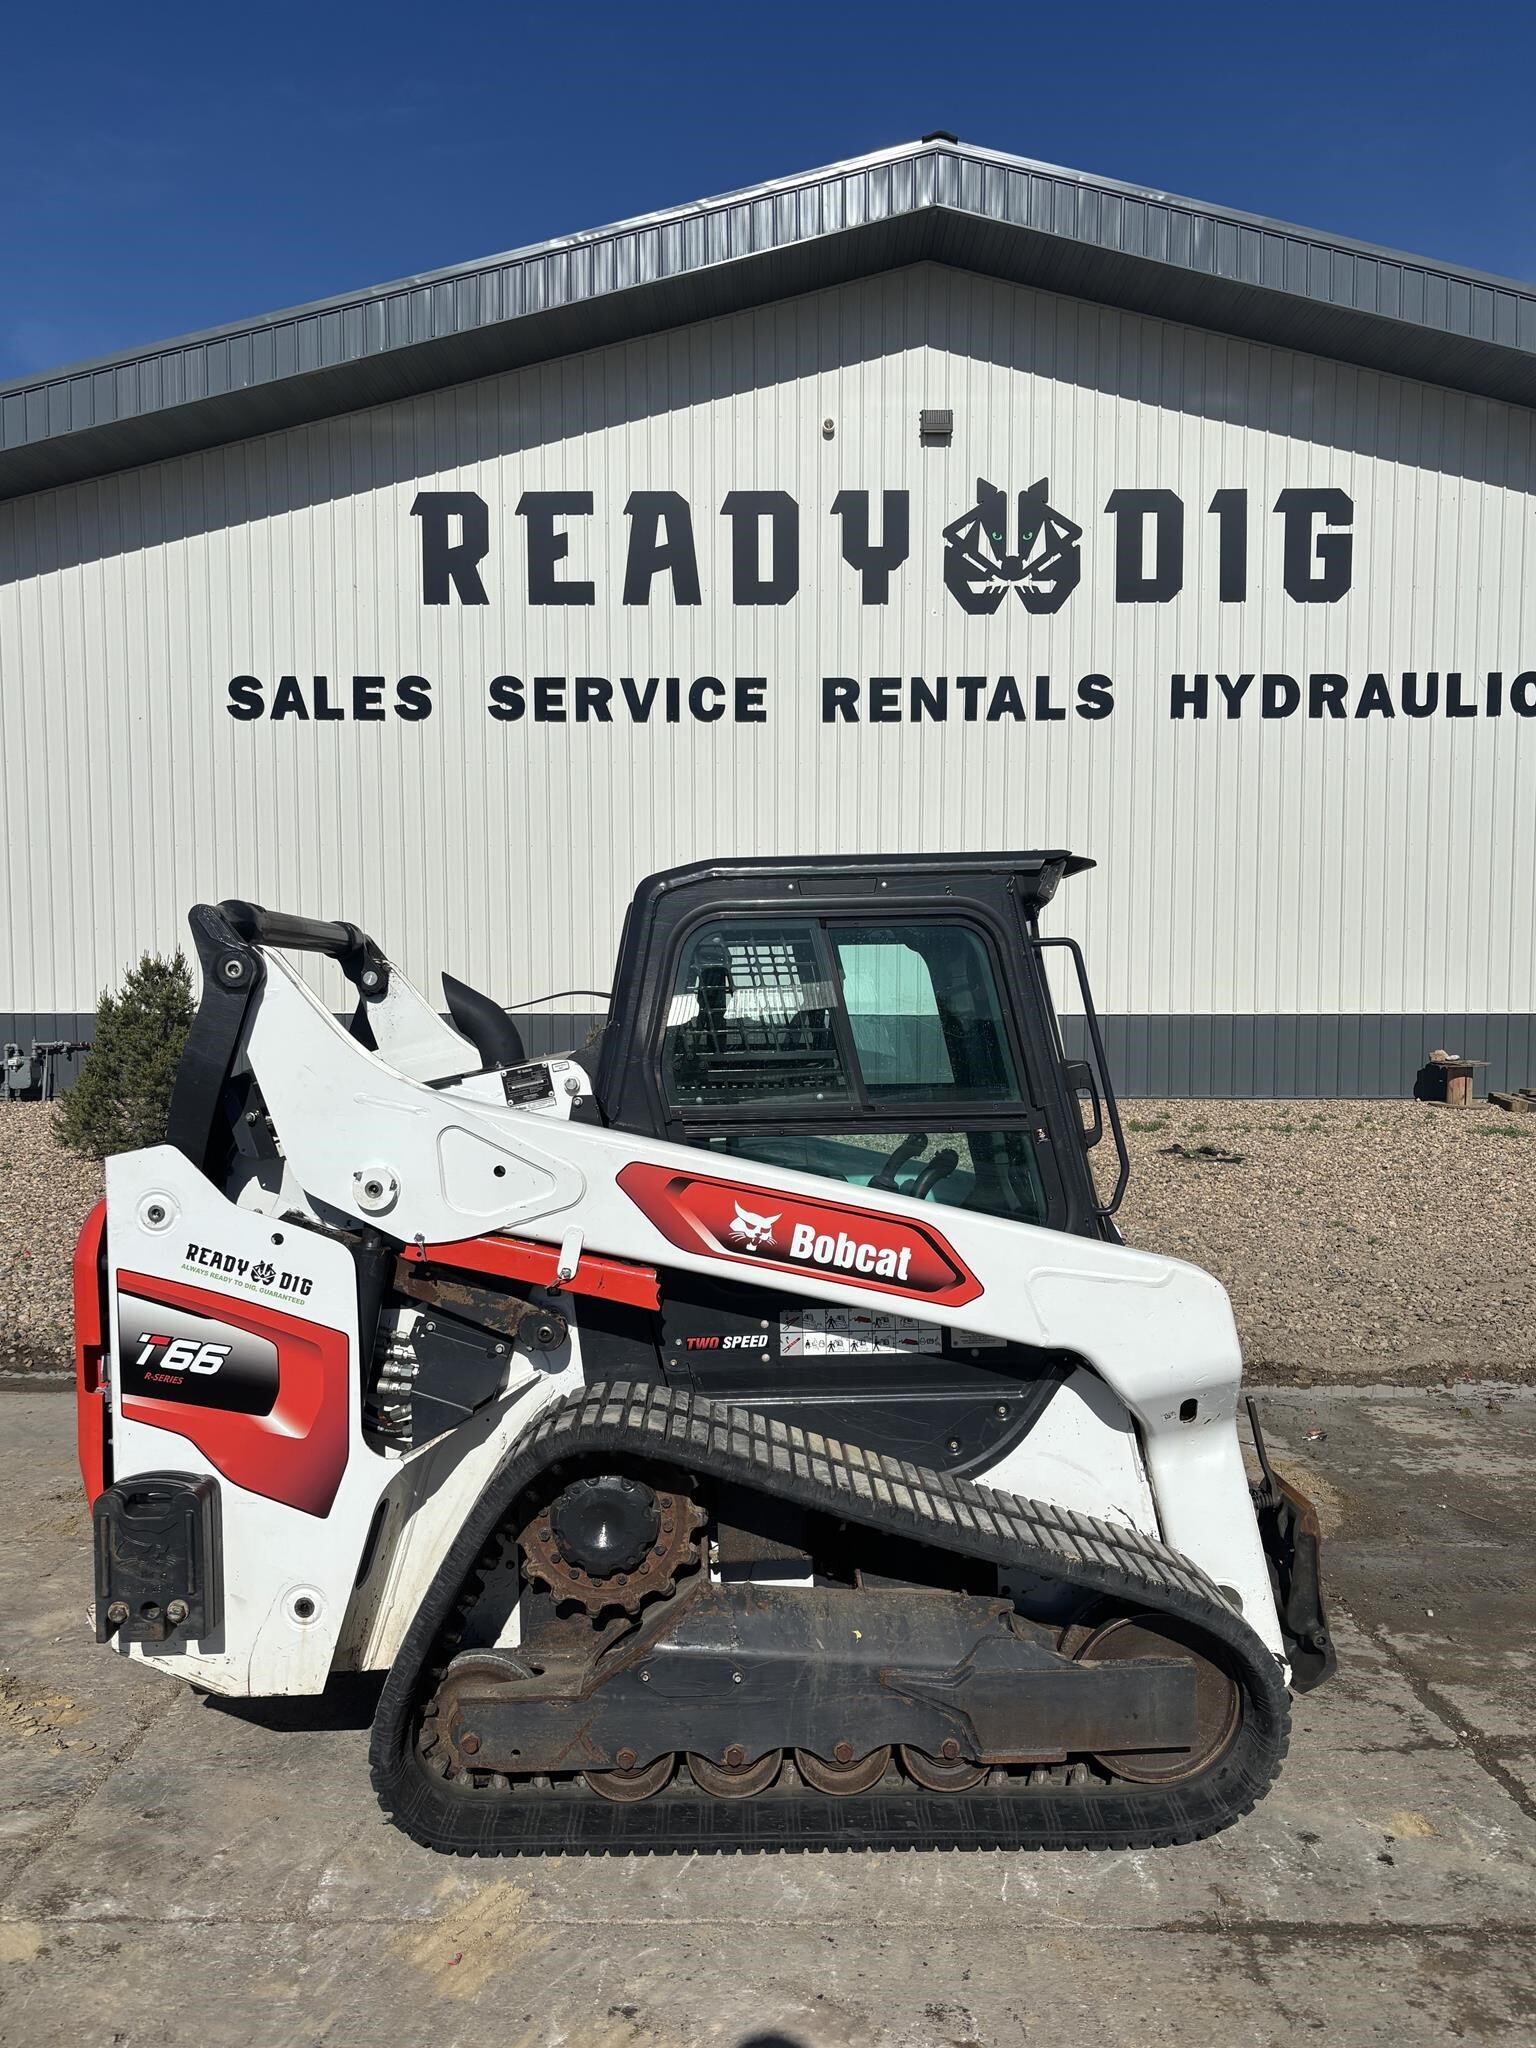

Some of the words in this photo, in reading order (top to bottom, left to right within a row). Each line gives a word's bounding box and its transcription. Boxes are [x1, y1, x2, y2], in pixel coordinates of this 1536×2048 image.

[410, 490, 910, 606] READY
[1103, 488, 1354, 603] DIG
[227, 675, 432, 721] SALES
[488, 675, 767, 723] SERVICE
[822, 673, 1115, 723] RENTALS
[1170, 671, 1536, 719] HYDRAULIC
[185, 1243, 250, 1277] READY
[278, 1271, 313, 1296] DIG
[789, 1222, 912, 1281] Bobcat
[181, 1263, 209, 1277] ALWAYS
[209, 1270, 233, 1285] READY
[234, 1279, 244, 1287] TO
[259, 1287, 305, 1305] GUARANTEED
[136, 1333, 233, 1375] T66
[687, 1336, 720, 1350] TWO
[722, 1334, 769, 1349] SPEED
[144, 1371, 184, 1385] R-SERIES
